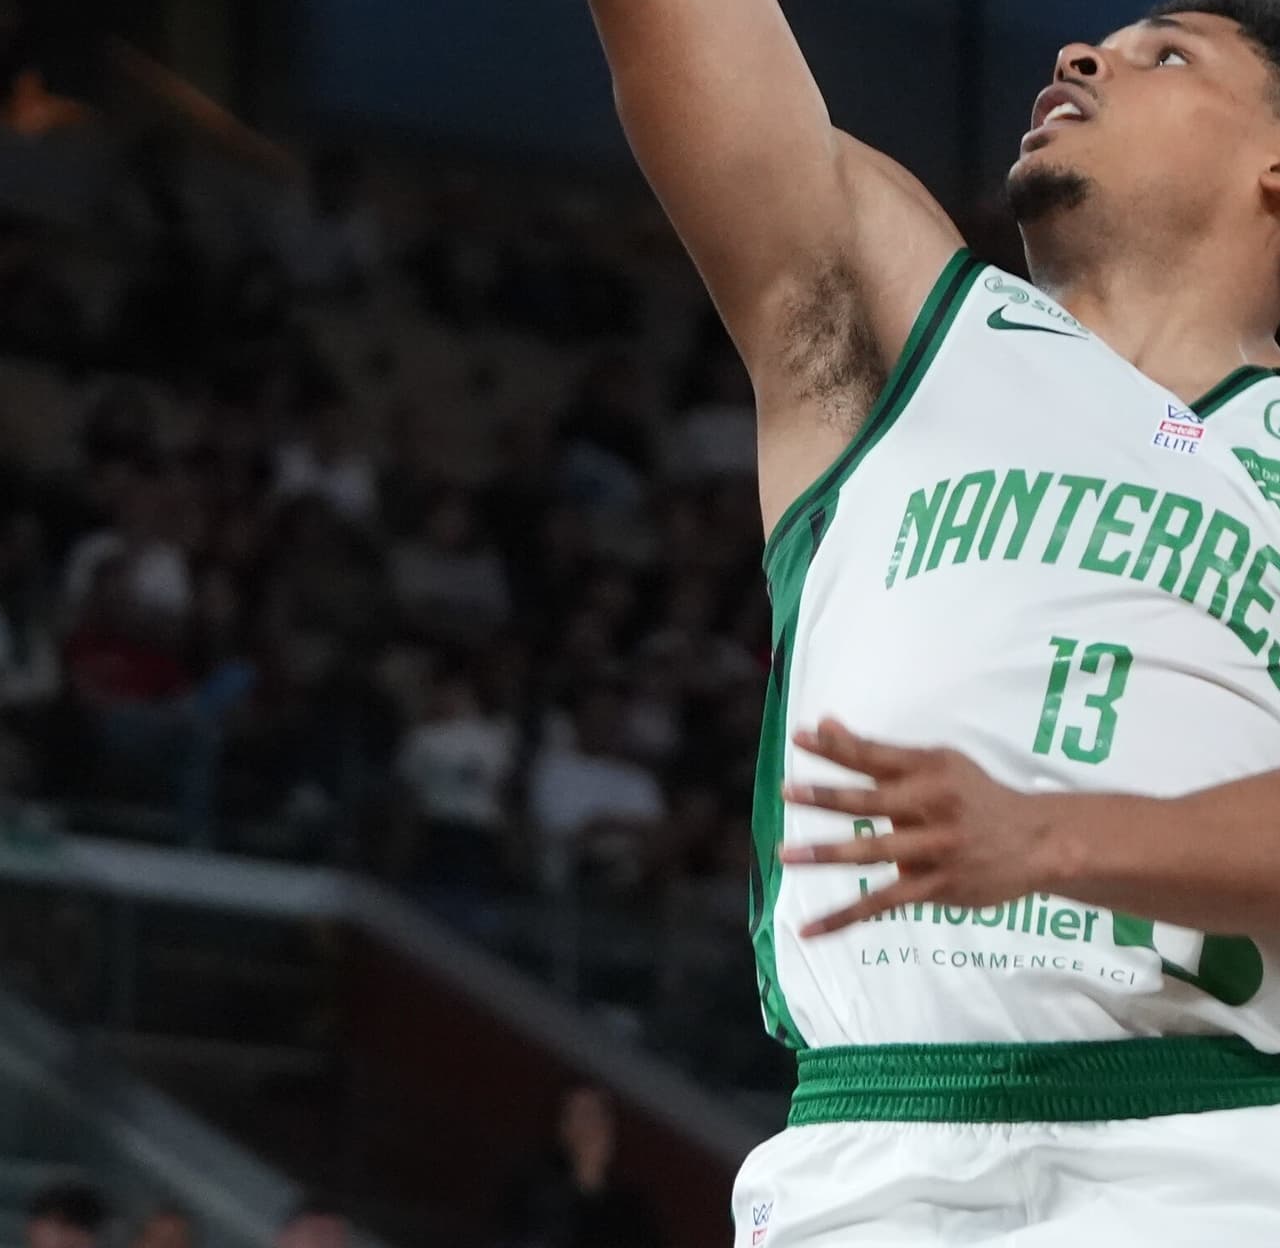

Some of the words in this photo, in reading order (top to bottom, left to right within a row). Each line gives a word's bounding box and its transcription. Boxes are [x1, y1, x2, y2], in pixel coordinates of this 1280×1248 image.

[1032, 635, 1133, 765] 13
[861, 948, 889, 966] LA
[932, 949, 1084, 972] COMMENCE
[1100, 966, 1136, 985] ICI
